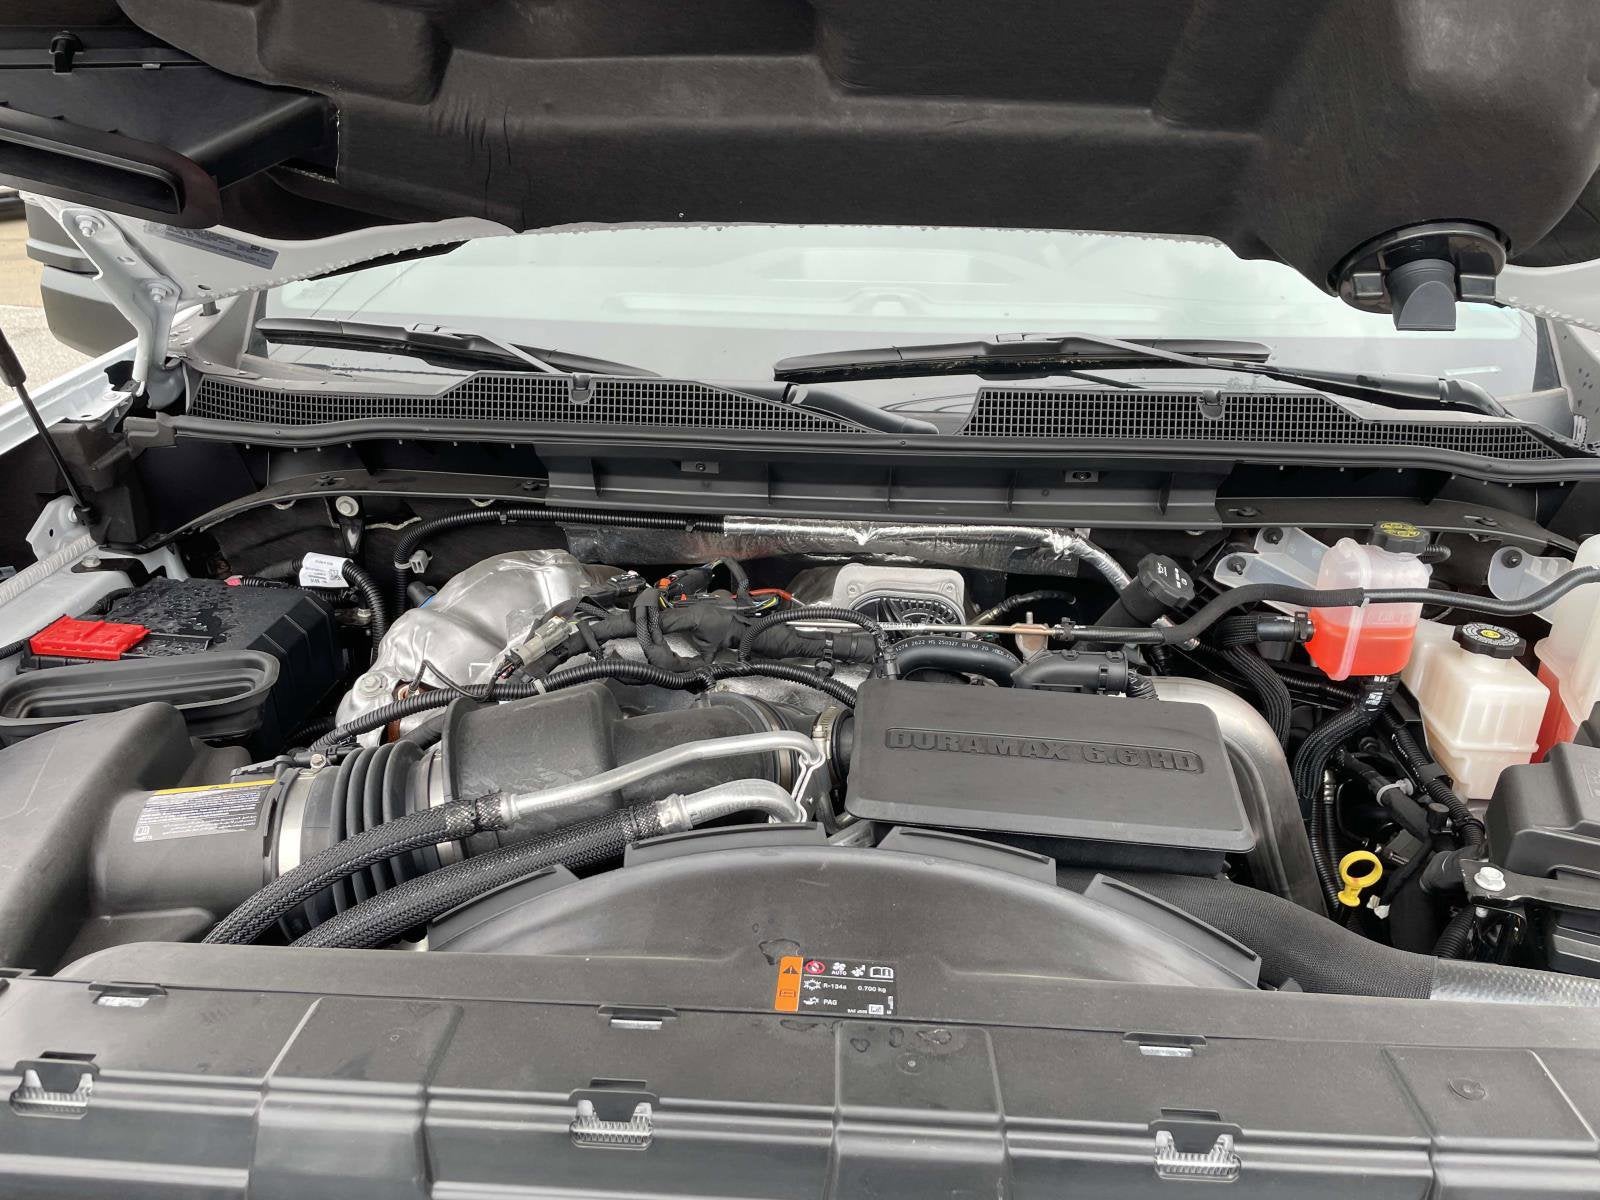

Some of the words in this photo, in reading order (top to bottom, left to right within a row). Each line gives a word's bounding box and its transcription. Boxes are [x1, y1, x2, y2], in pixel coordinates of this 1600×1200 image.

[888, 730, 1071, 761] DURAMAX
[1082, 746, 1141, 767] 6.6
[1148, 750, 1203, 773] HD
[823, 998, 838, 1006] PAG
